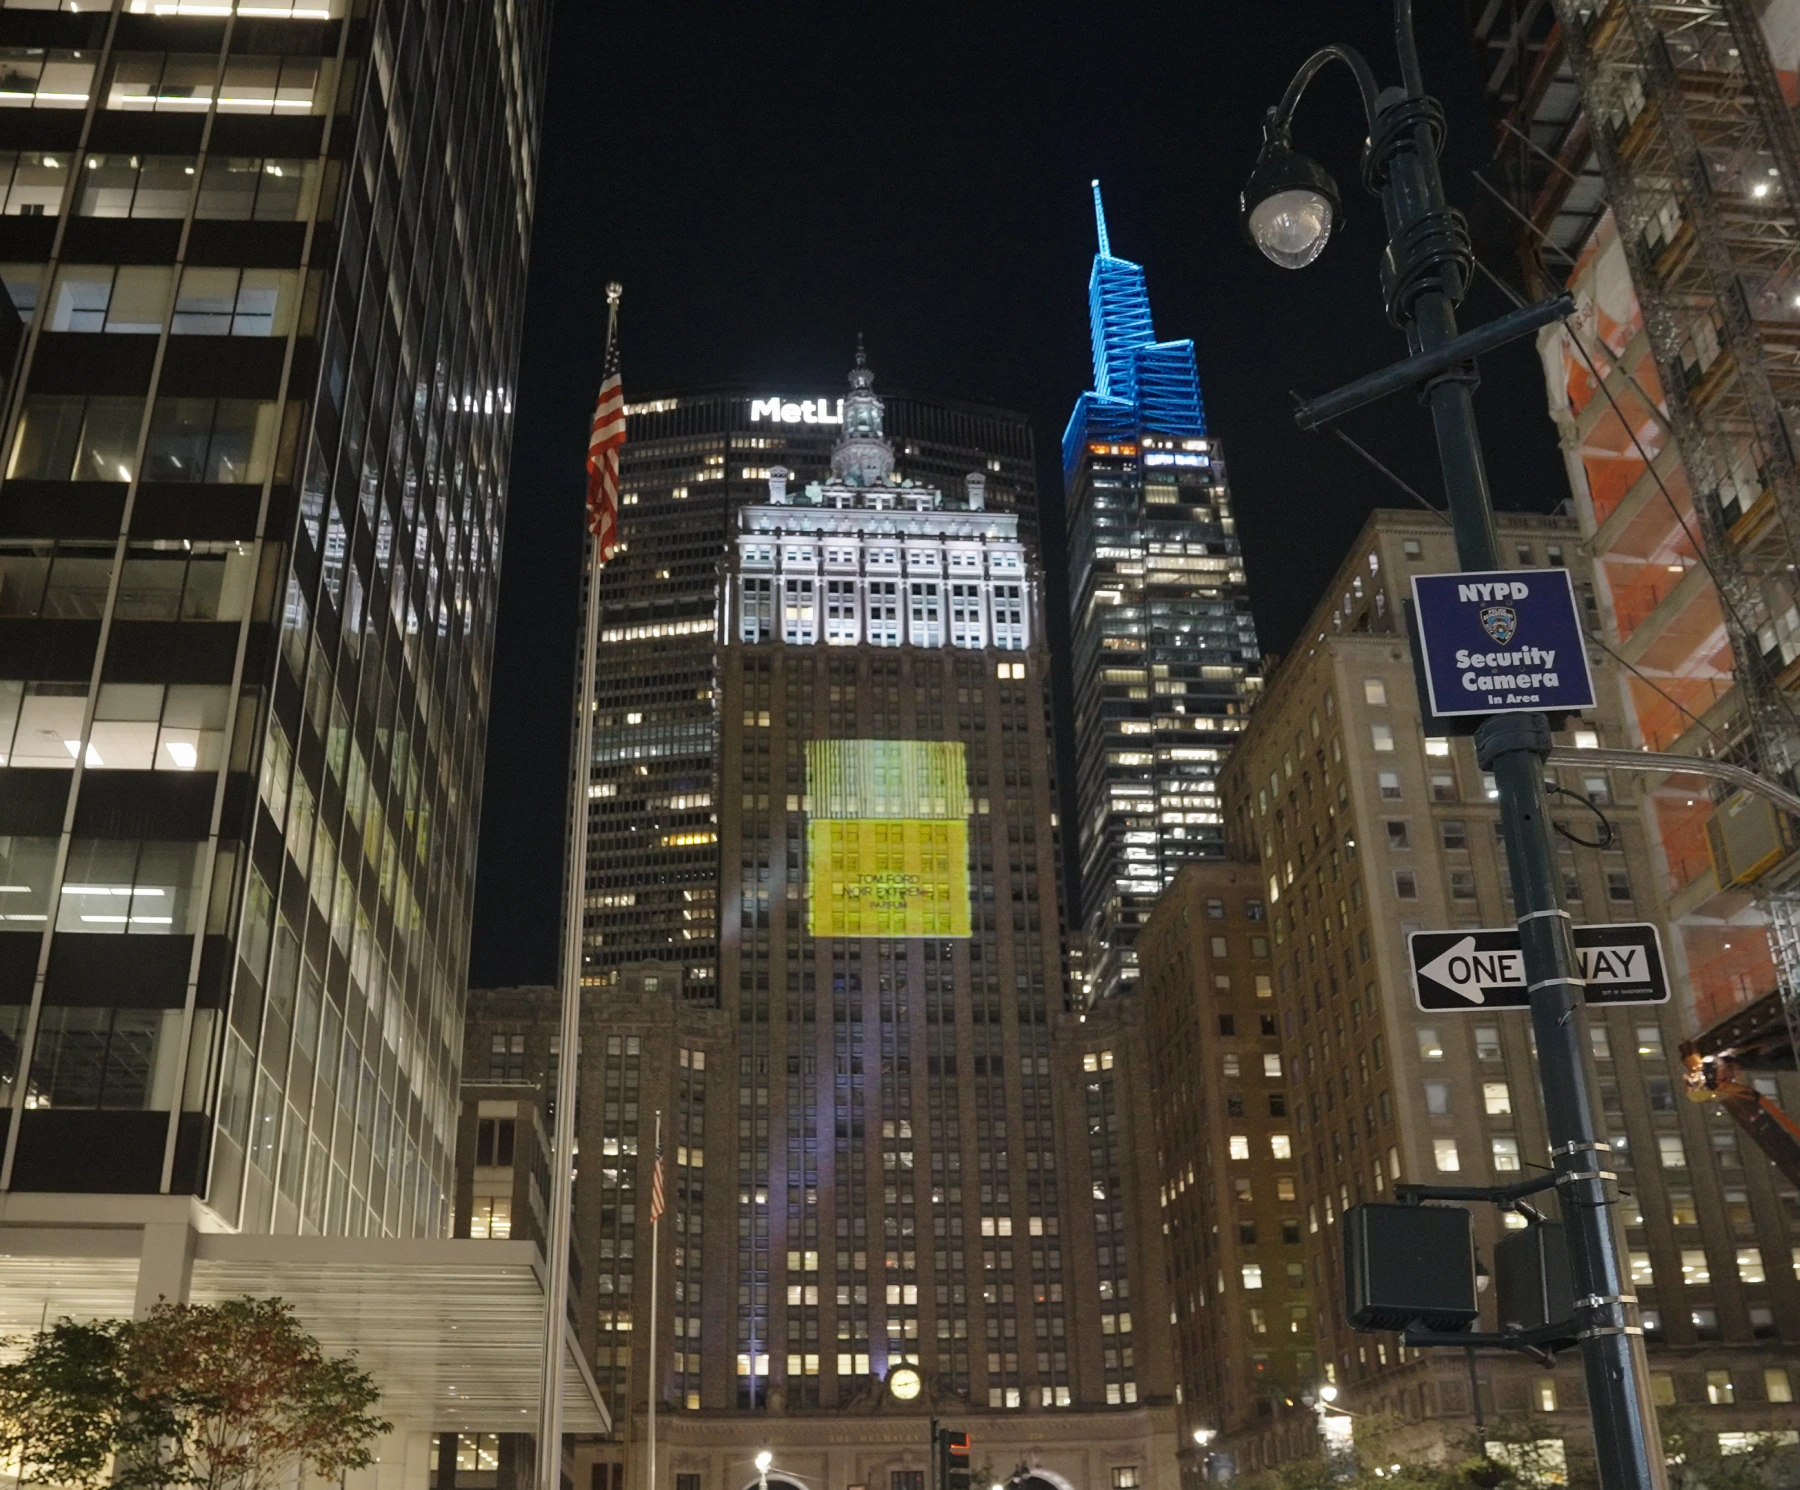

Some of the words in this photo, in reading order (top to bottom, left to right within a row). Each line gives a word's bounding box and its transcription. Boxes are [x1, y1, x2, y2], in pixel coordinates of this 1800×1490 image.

[750, 396, 845, 424] MetLi
[1458, 582, 1529, 602] NYPD
[1455, 645, 1556, 669] Security
[1462, 671, 1560, 691] Camera
[1488, 694, 1502, 705] In
[1506, 693, 1540, 704] Area
[857, 874, 883, 884] TOM
[887, 874, 920, 884] FORD
[843, 886, 872, 898] NOIR
[1448, 954, 1521, 984] ONE
